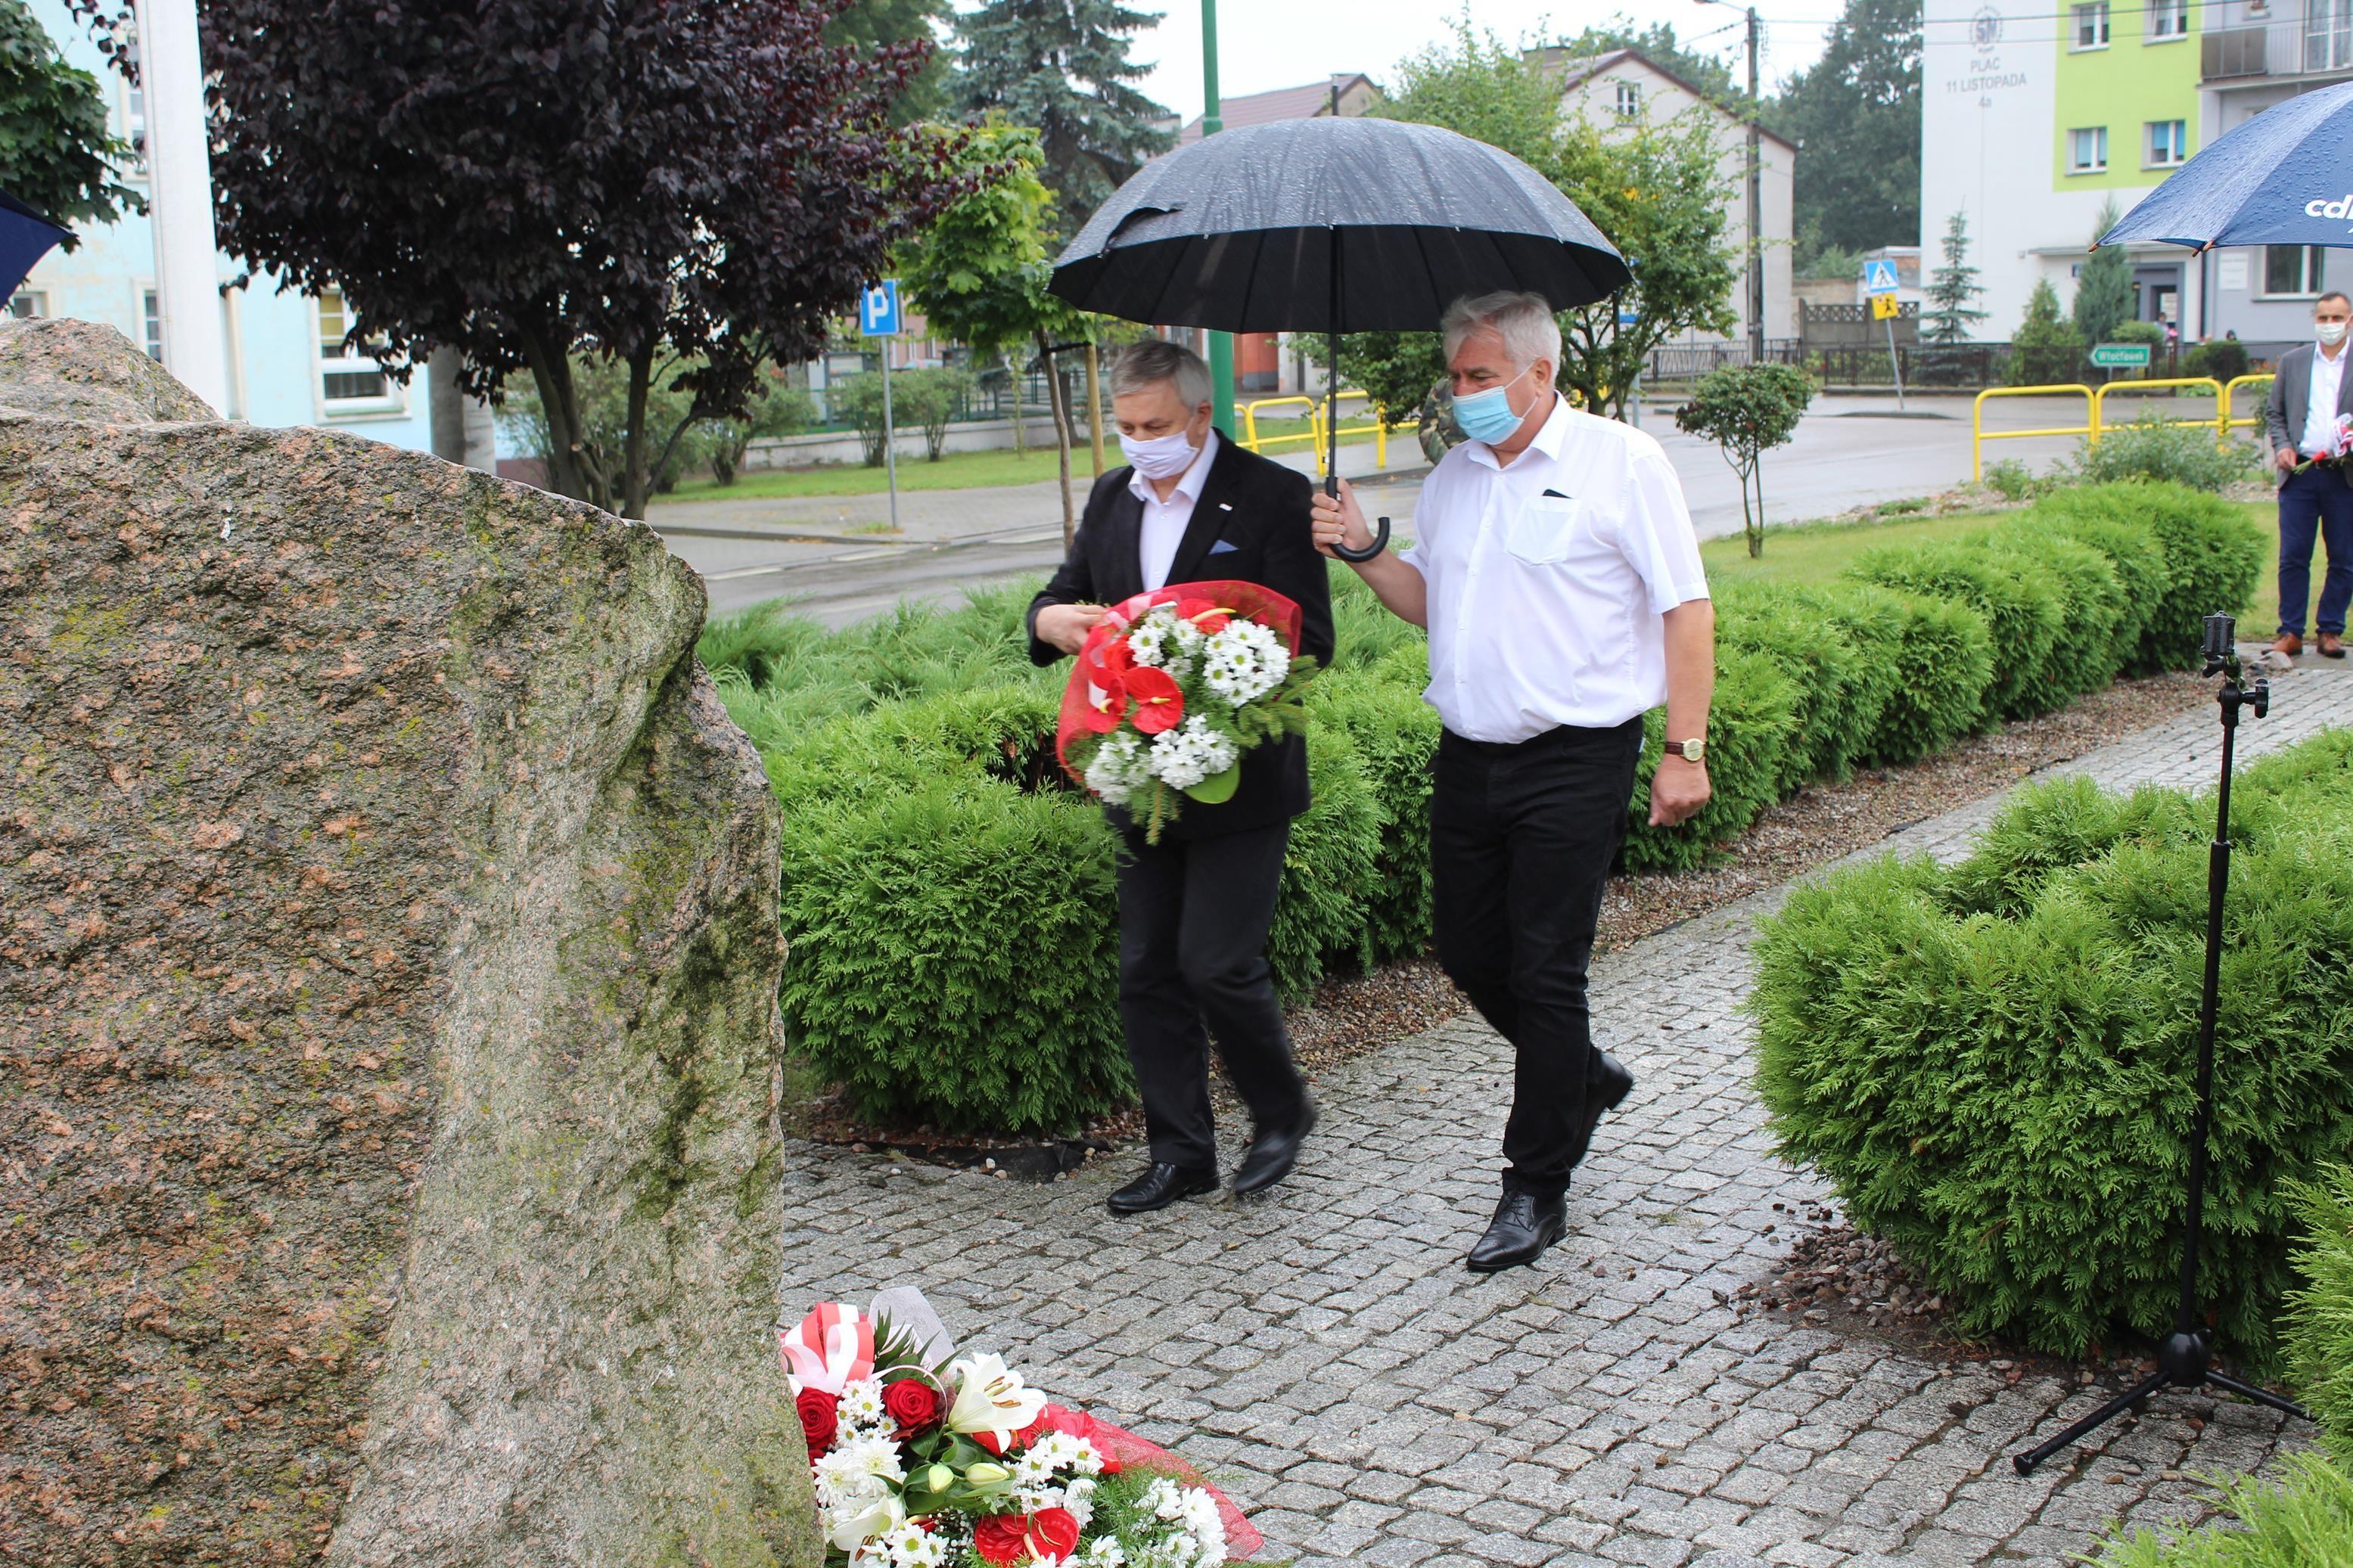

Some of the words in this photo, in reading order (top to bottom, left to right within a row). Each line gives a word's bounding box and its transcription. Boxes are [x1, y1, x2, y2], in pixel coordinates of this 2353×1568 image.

[1976, 17, 1997, 43] SM
[1970, 57, 2000, 72] PLAC
[1947, 80, 1957, 93] 11
[1961, 73, 2027, 92] LISTOPADA
[1978, 95, 1992, 108] 4a
[2305, 194, 2353, 219] cd
[868, 287, 889, 328] P
